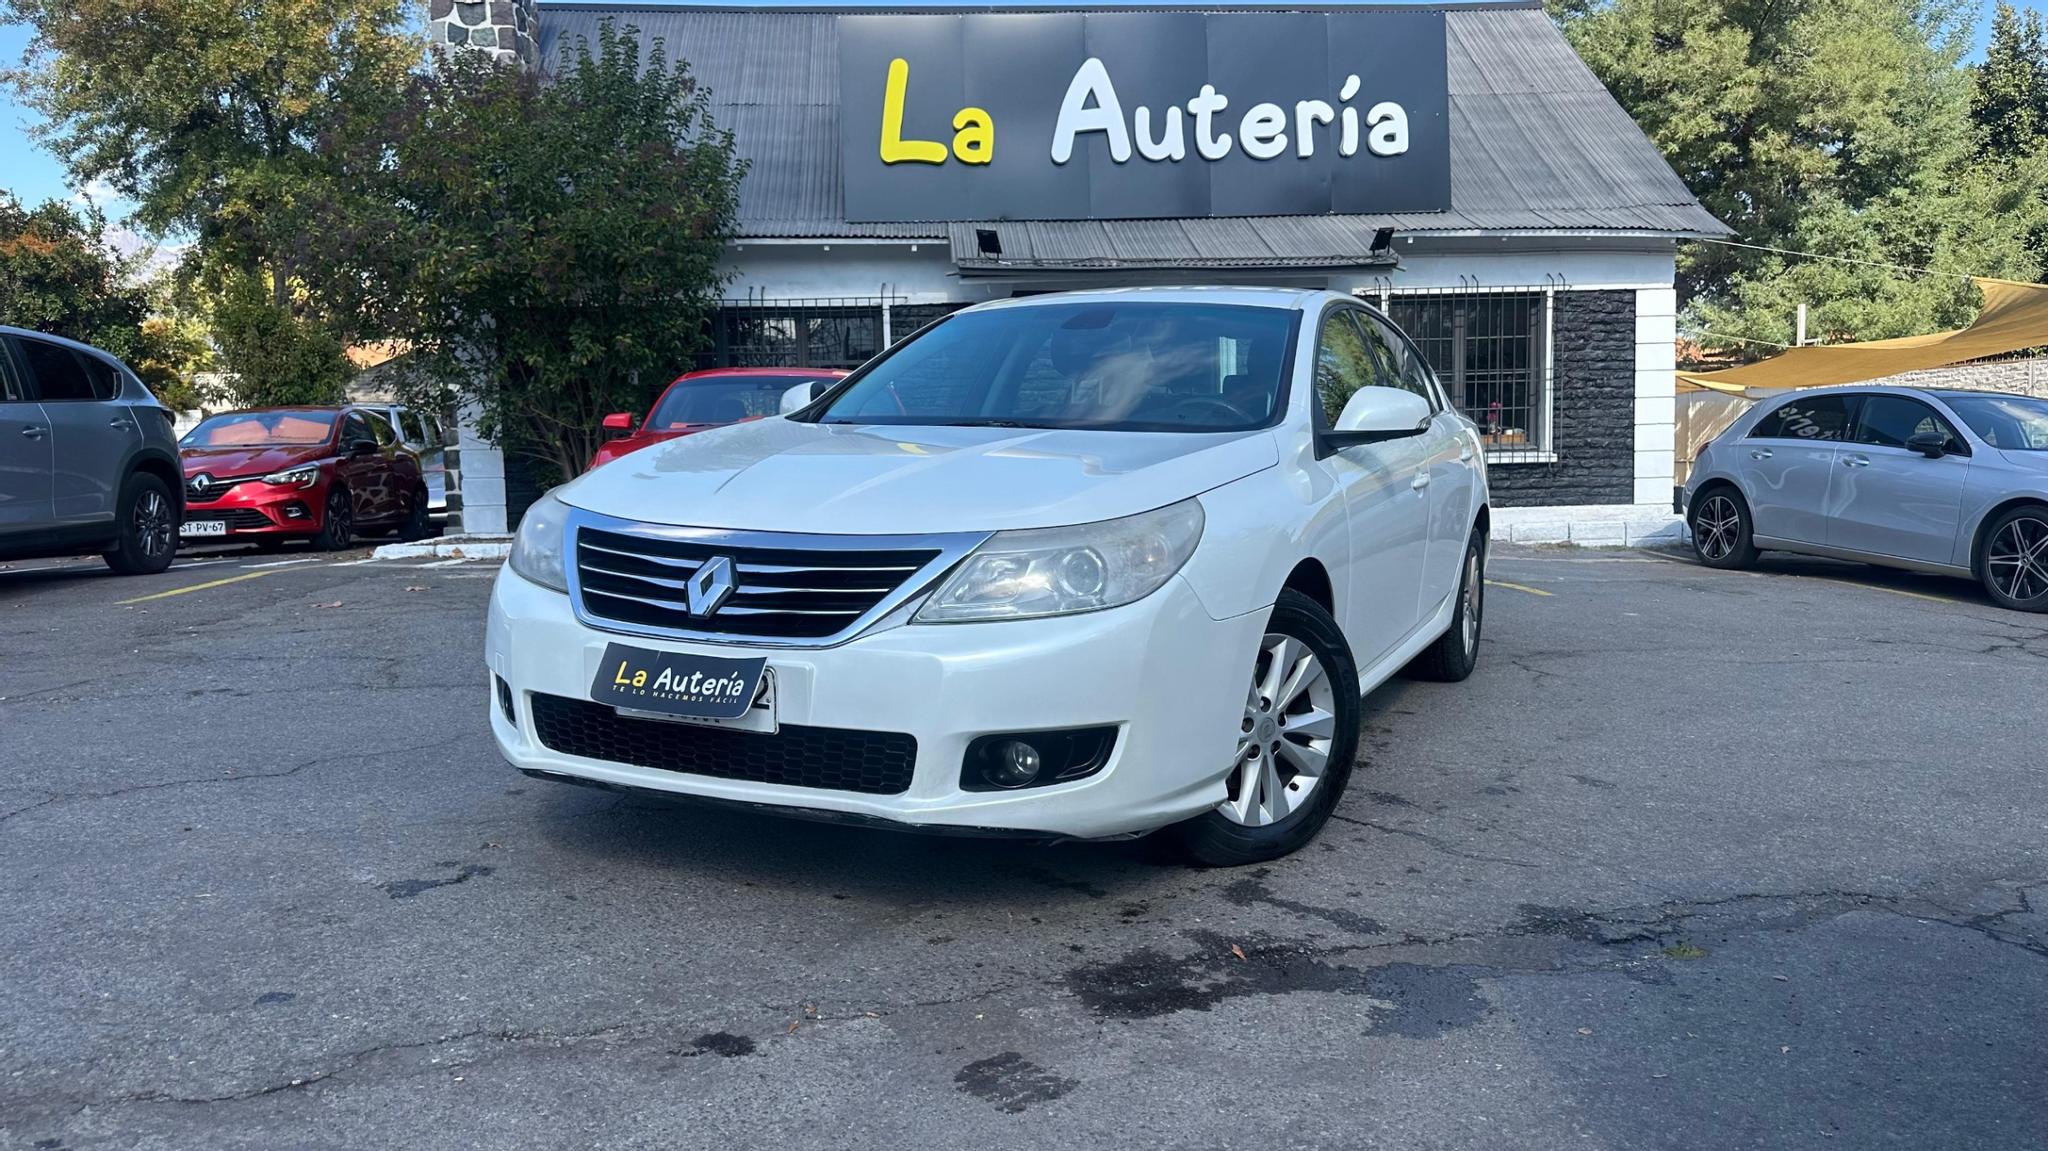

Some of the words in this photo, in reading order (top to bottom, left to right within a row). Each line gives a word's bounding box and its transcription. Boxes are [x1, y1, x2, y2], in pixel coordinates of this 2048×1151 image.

[880, 58, 994, 165] La
[1050, 57, 1410, 164] Autería
[615, 660, 648, 687] La
[653, 667, 745, 697] Autería
[653, 691, 703, 702] HACEMOS
